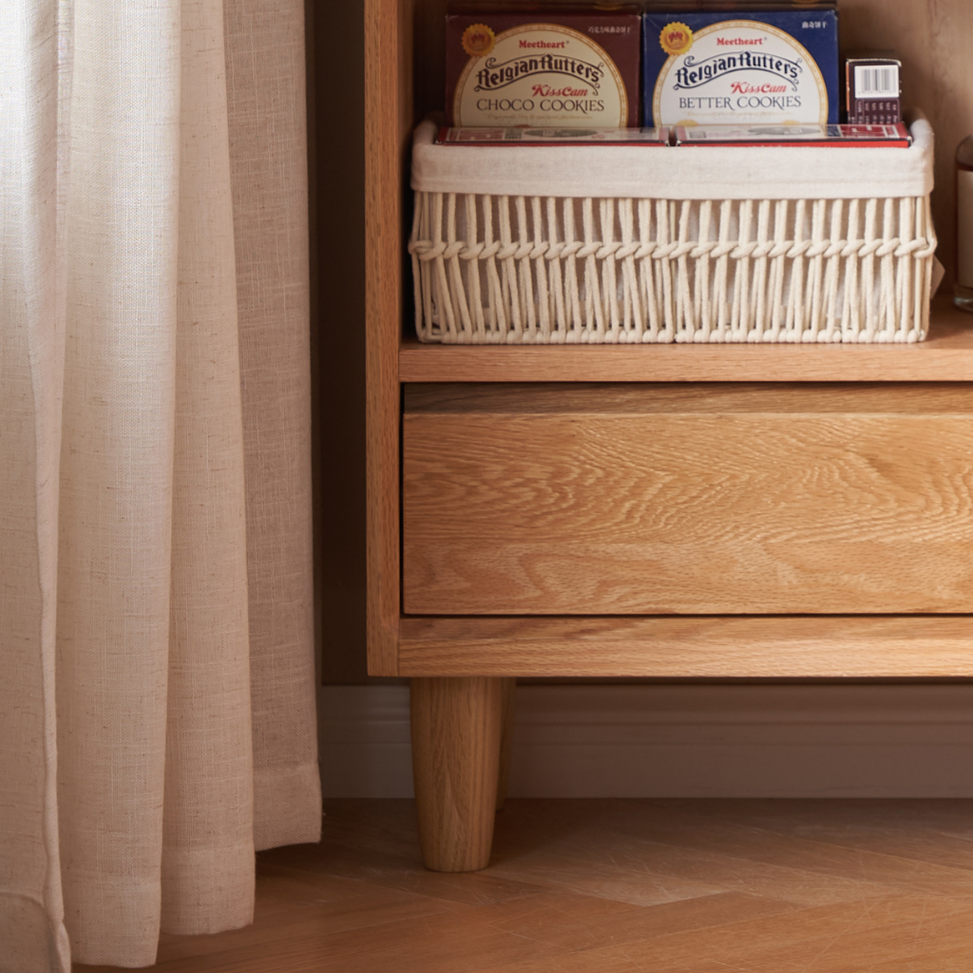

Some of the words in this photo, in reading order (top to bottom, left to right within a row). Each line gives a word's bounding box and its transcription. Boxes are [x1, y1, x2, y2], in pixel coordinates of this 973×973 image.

[587, 25, 631, 35] 巧克力味曲奇饼干
[801, 20, 828, 30] 曲奇饼干
[519, 40, 566, 49] Meetheart
[717, 37, 763, 46] Meetheart
[531, 84, 588, 97] KissCam
[730, 81, 787, 94] KissCam
[476, 98, 535, 112] CHOCO
[540, 98, 605, 114] COOKIES
[679, 95, 736, 111] BETTER
[736, 95, 802, 111] COOKIES
